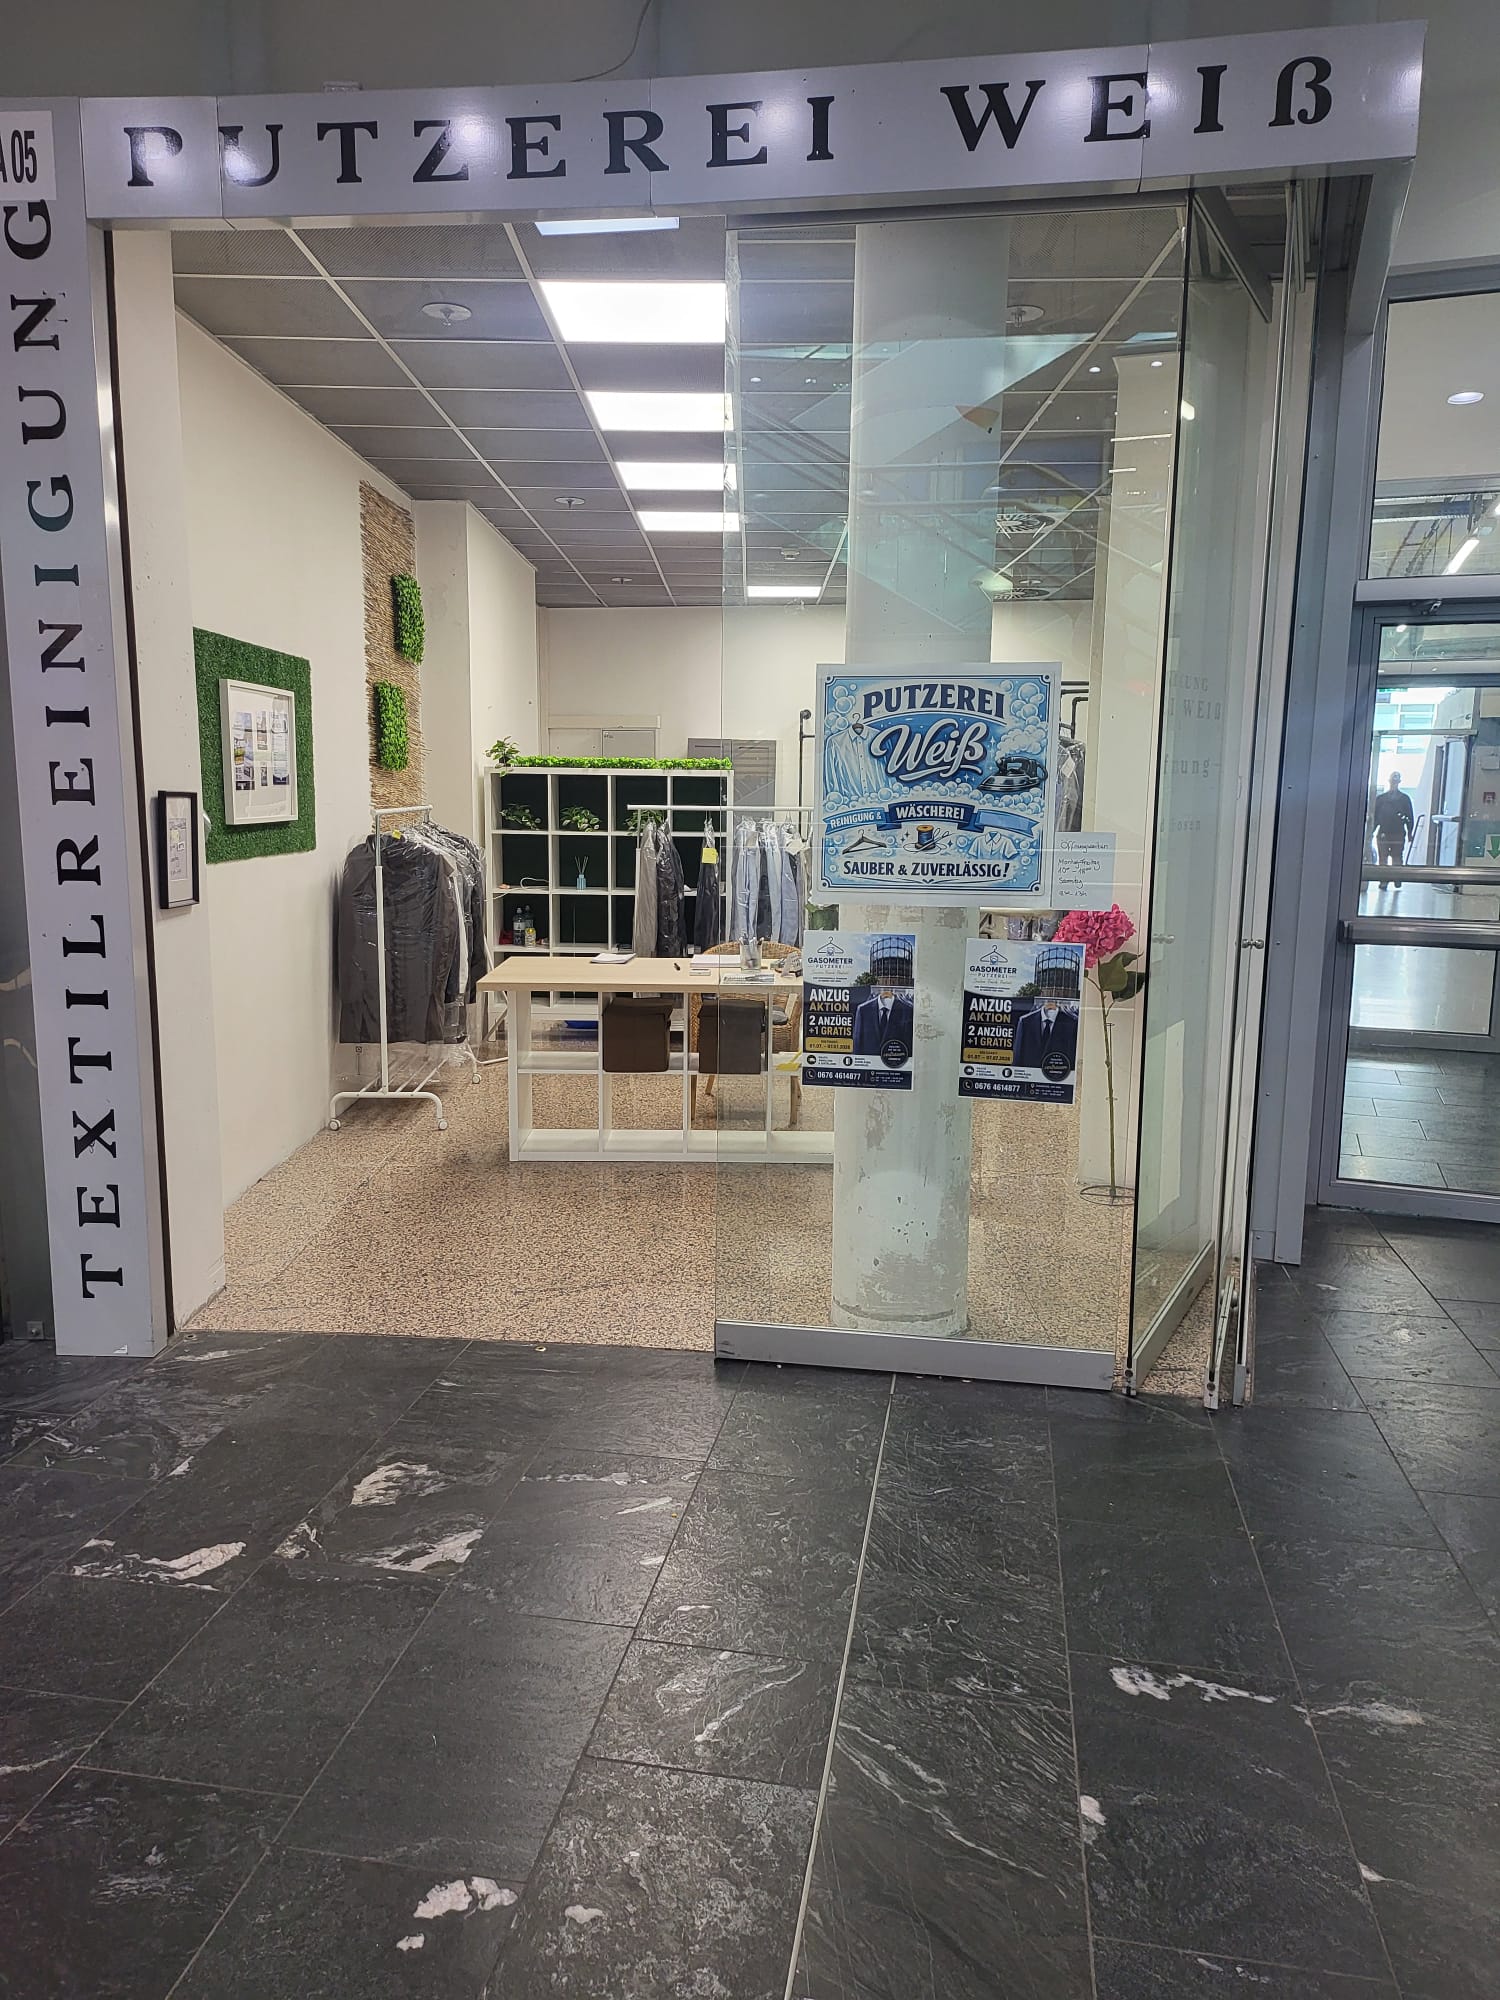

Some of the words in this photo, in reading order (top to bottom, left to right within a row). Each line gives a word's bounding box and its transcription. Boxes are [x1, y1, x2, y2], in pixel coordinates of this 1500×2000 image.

[123, 96, 836, 188] PUTZEREI
[940, 56, 1333, 152] WEIß
[11, 129, 38, 184] 05
[863, 683, 1005, 720] PUTZEREI
[3, 198, 125, 1299] TEXTILREINIGUNG
[870, 718, 988, 780] Weiß
[895, 804, 965, 820] WÄSCHEREI
[830, 812, 875, 829] REINIGUNG
[843, 860, 895, 876] SAUBER
[897, 864, 907, 875] &
[911, 860, 1010, 878] ZUVERLÄSSIG!
[807, 957, 853, 965] GASOMETER
[970, 965, 1017, 974] GASOMETER
[809, 988, 850, 1002] ANZUG
[809, 1002, 850, 1012] AKTION
[970, 998, 1012, 1013] ANZUG
[809, 1015, 816, 1026] 2
[818, 1015, 852, 1026] ANZÜGE
[969, 1012, 1011, 1023] AKTION
[809, 1026, 818, 1035] +1
[821, 1026, 852, 1036] GRATIS
[968, 1025, 975, 1036] 2
[977, 1026, 1014, 1038] ANZÜGE
[967, 1037, 977, 1045] +1
[980, 1037, 1013, 1048] GRATIS
[817, 1071, 834, 1079] 0676
[974, 1082, 992, 1090] 0676
